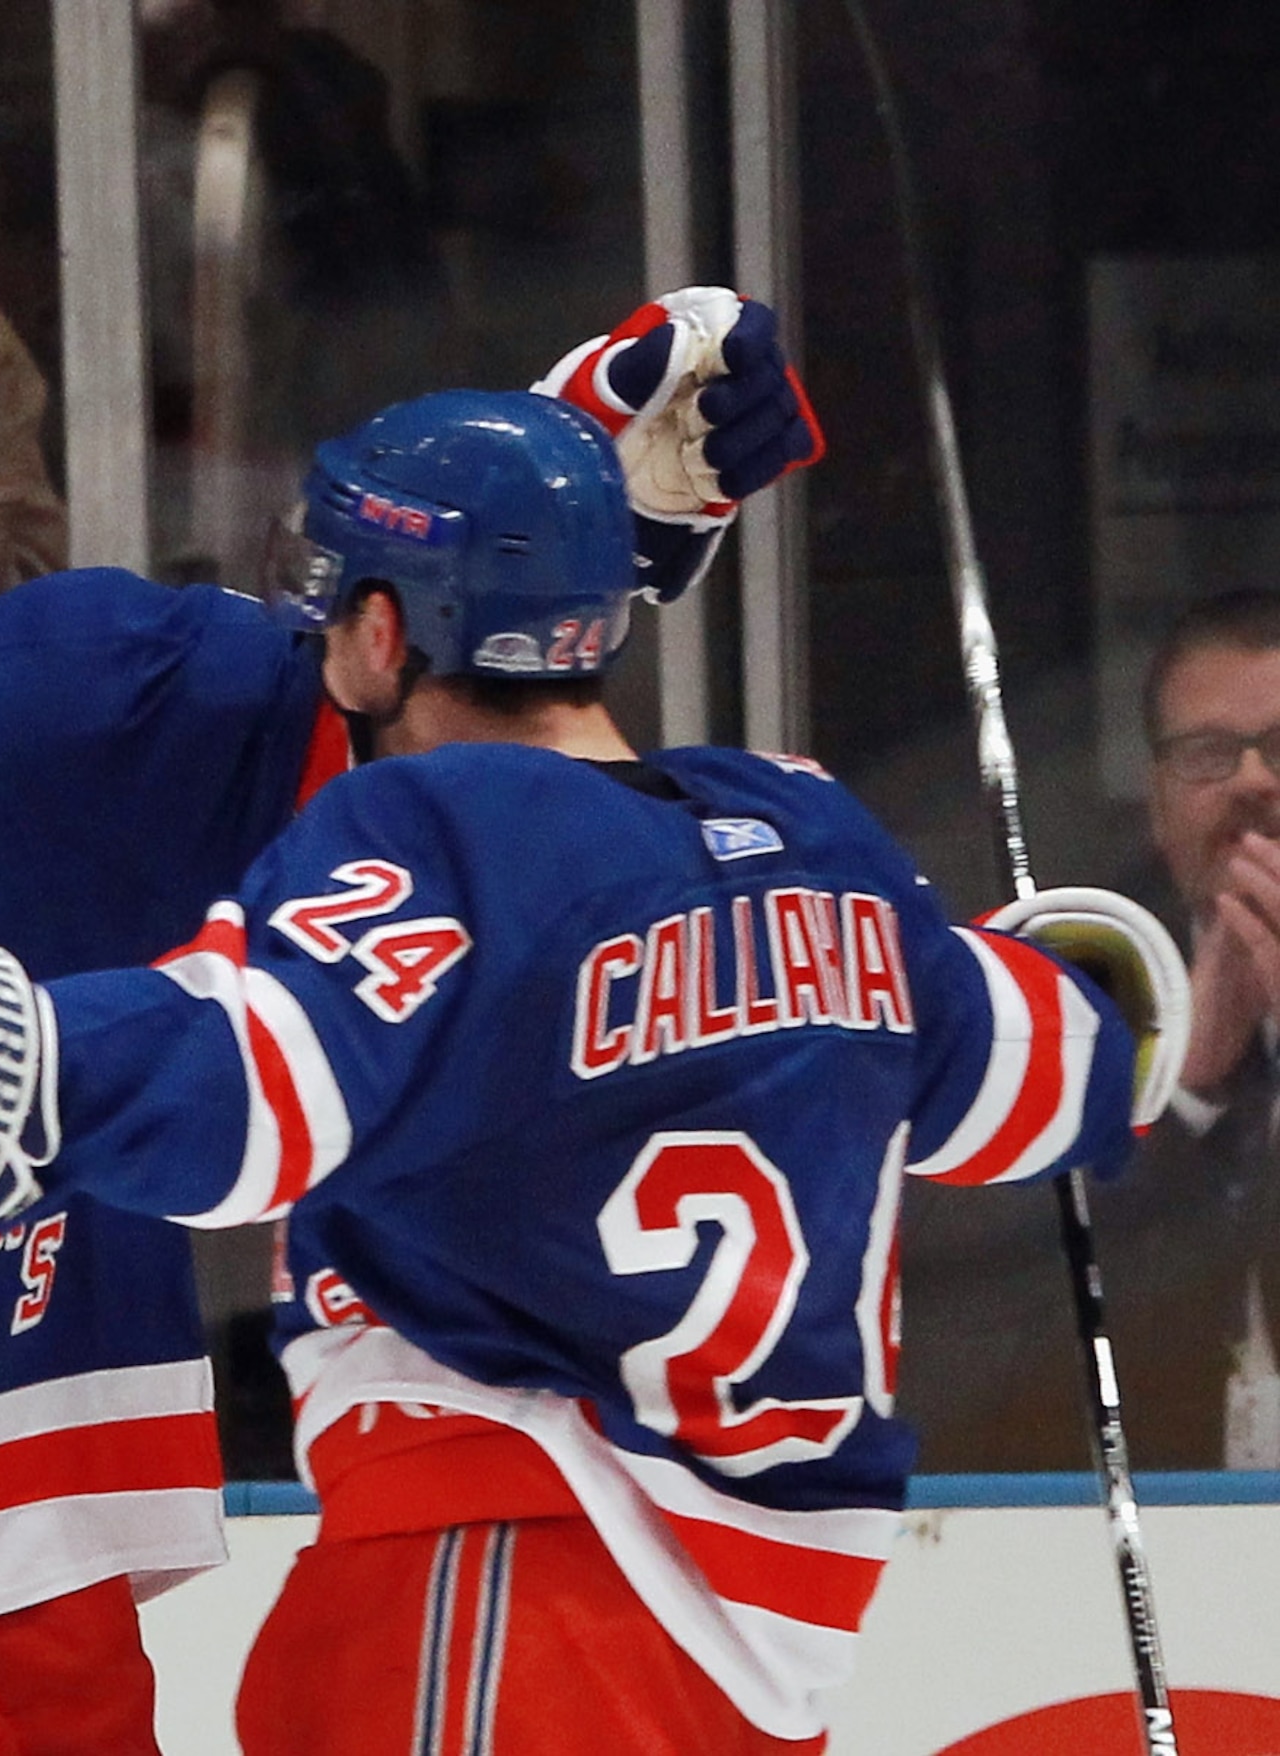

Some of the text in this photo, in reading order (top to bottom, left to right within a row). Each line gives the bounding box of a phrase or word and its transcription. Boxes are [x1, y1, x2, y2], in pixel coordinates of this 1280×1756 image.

[361, 493, 432, 540] NYR
[546, 619, 606, 671] 24
[267, 858, 475, 1024] 24
[569, 886, 914, 1081] CALLAHA
